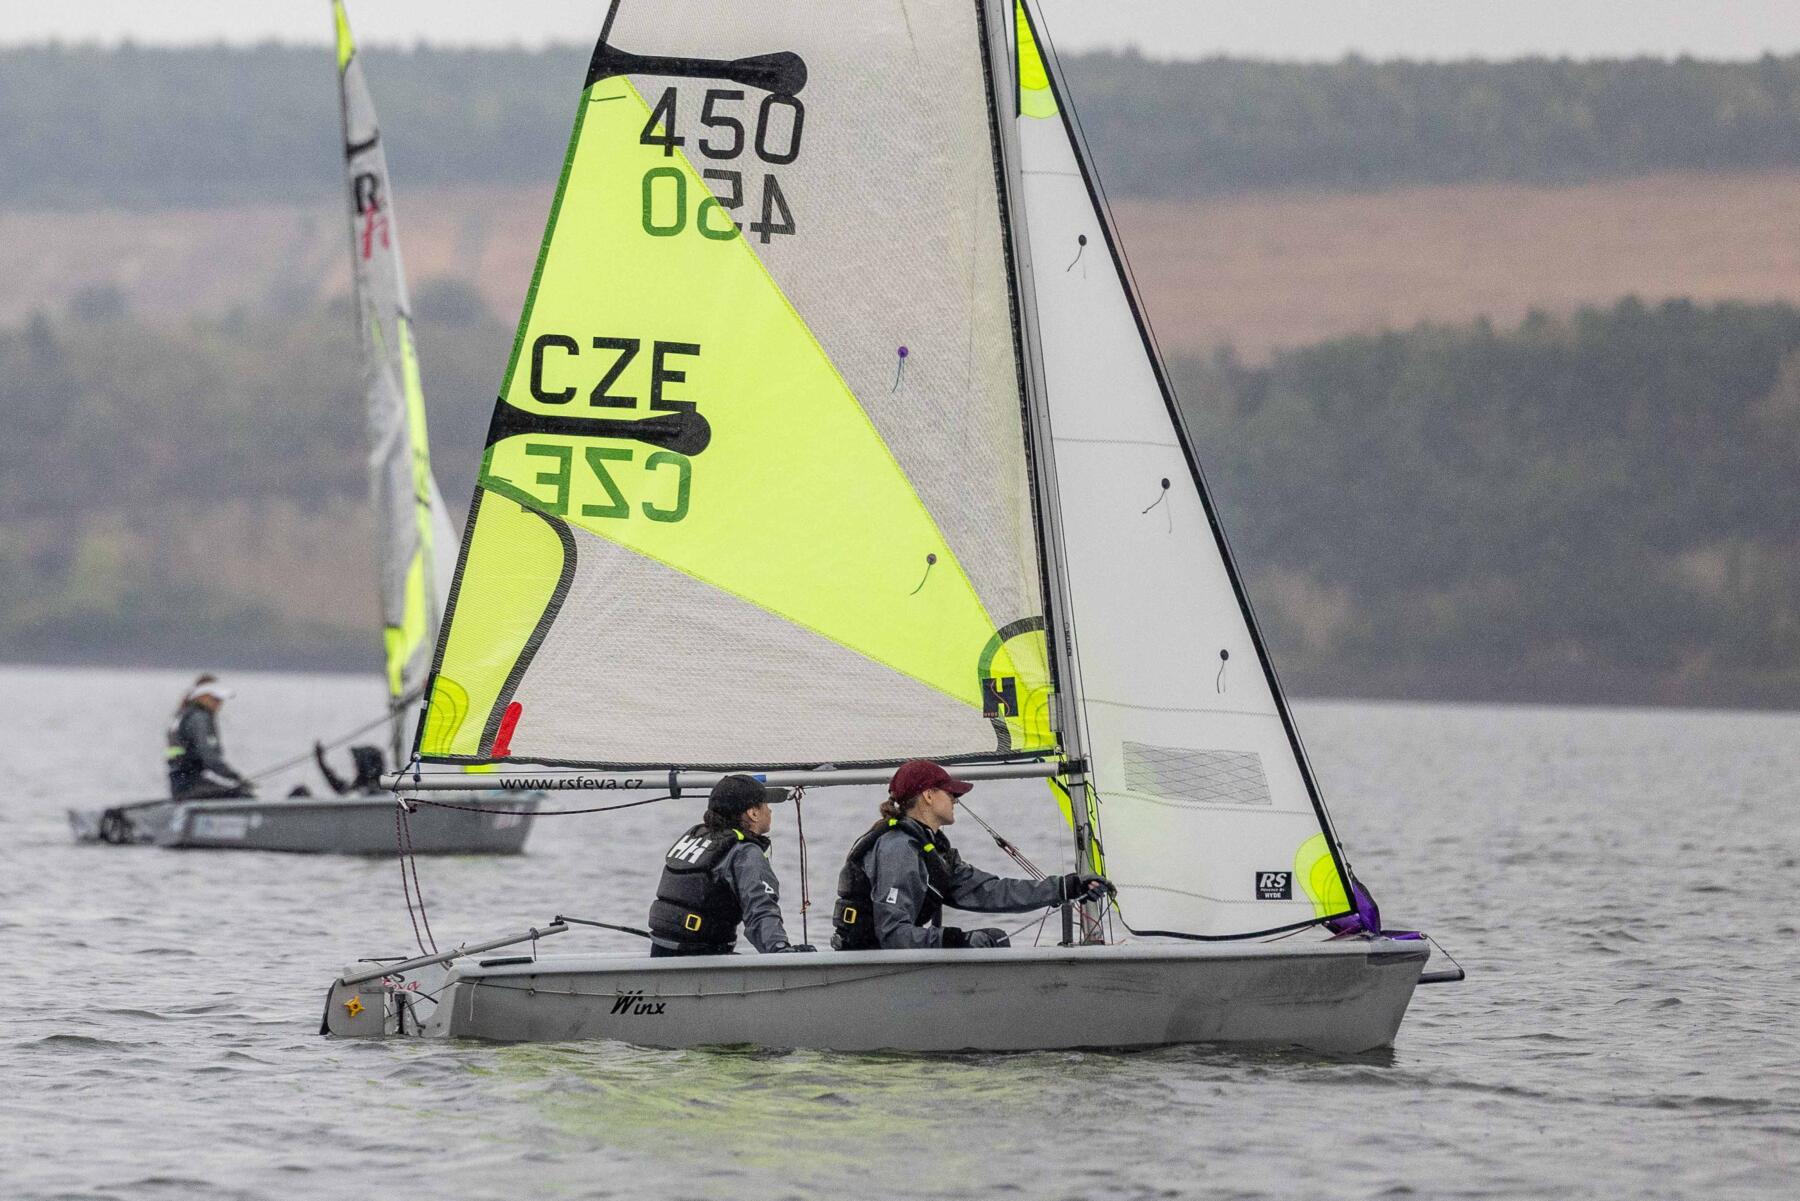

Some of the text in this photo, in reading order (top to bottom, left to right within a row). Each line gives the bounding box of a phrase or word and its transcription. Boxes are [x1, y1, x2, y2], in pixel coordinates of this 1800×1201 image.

[639, 86, 806, 166] 450
[530, 333, 701, 412] CZE
[499, 775, 644, 791] www.rsfeva.cz
[1260, 873, 1288, 888] RS
[610, 990, 667, 1015] Winx
